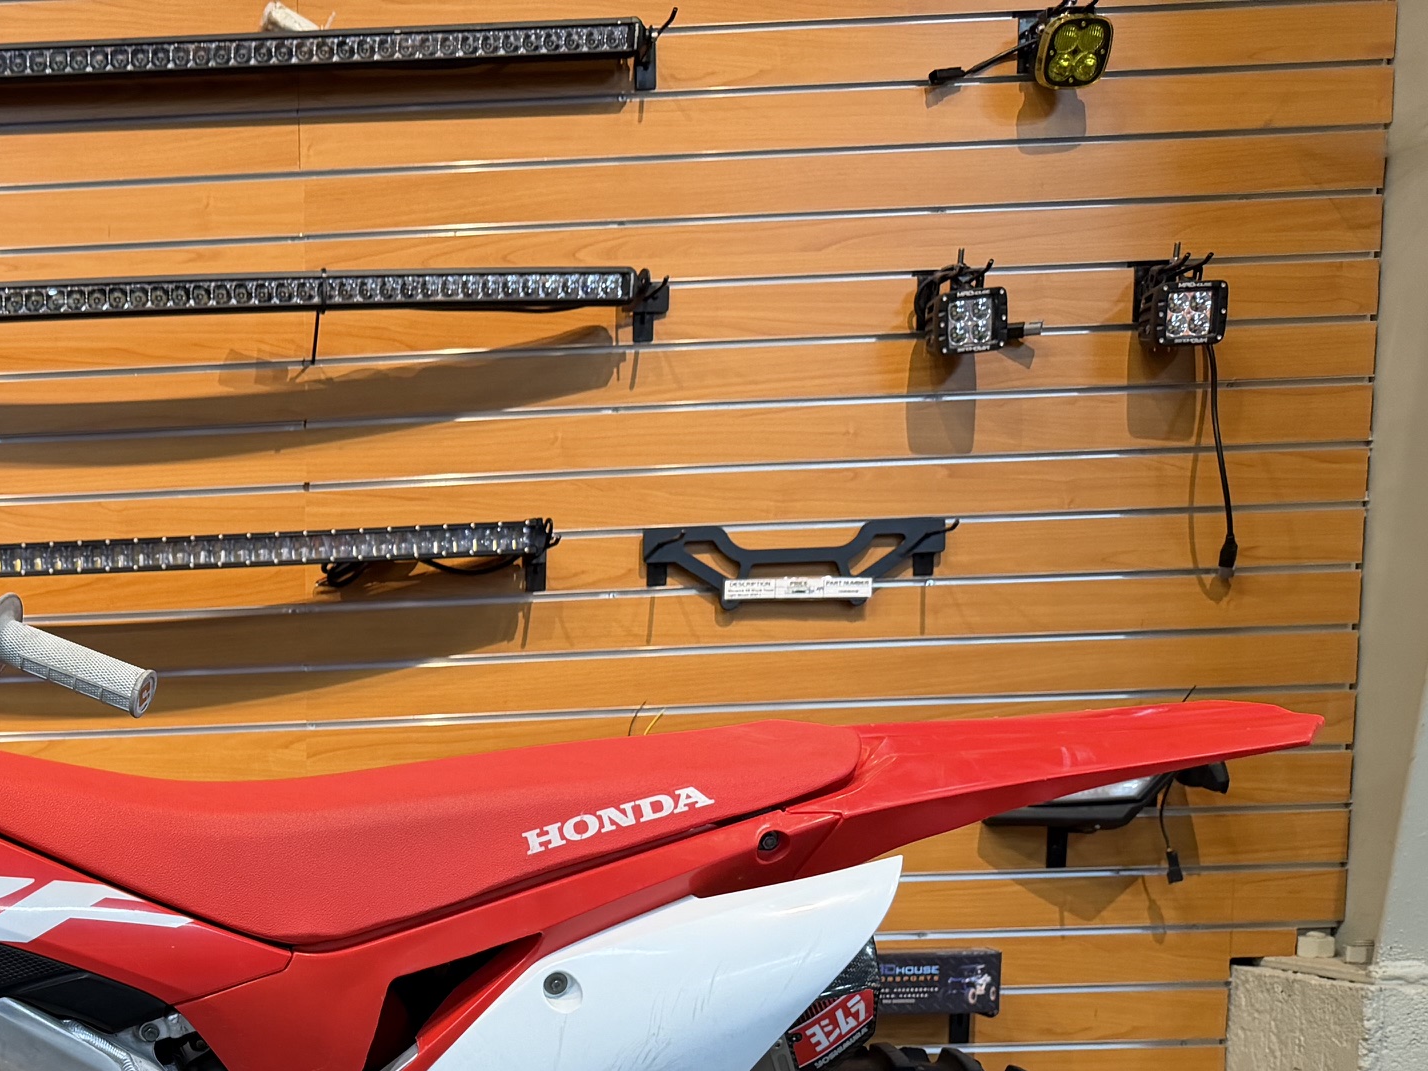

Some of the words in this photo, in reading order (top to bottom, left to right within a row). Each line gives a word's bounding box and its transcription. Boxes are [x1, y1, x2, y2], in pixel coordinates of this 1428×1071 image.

[522, 786, 715, 856] HONDA
[805, 994, 867, 1053] ヨシムラ
[814, 1025, 870, 1069] YOSHIMURA
